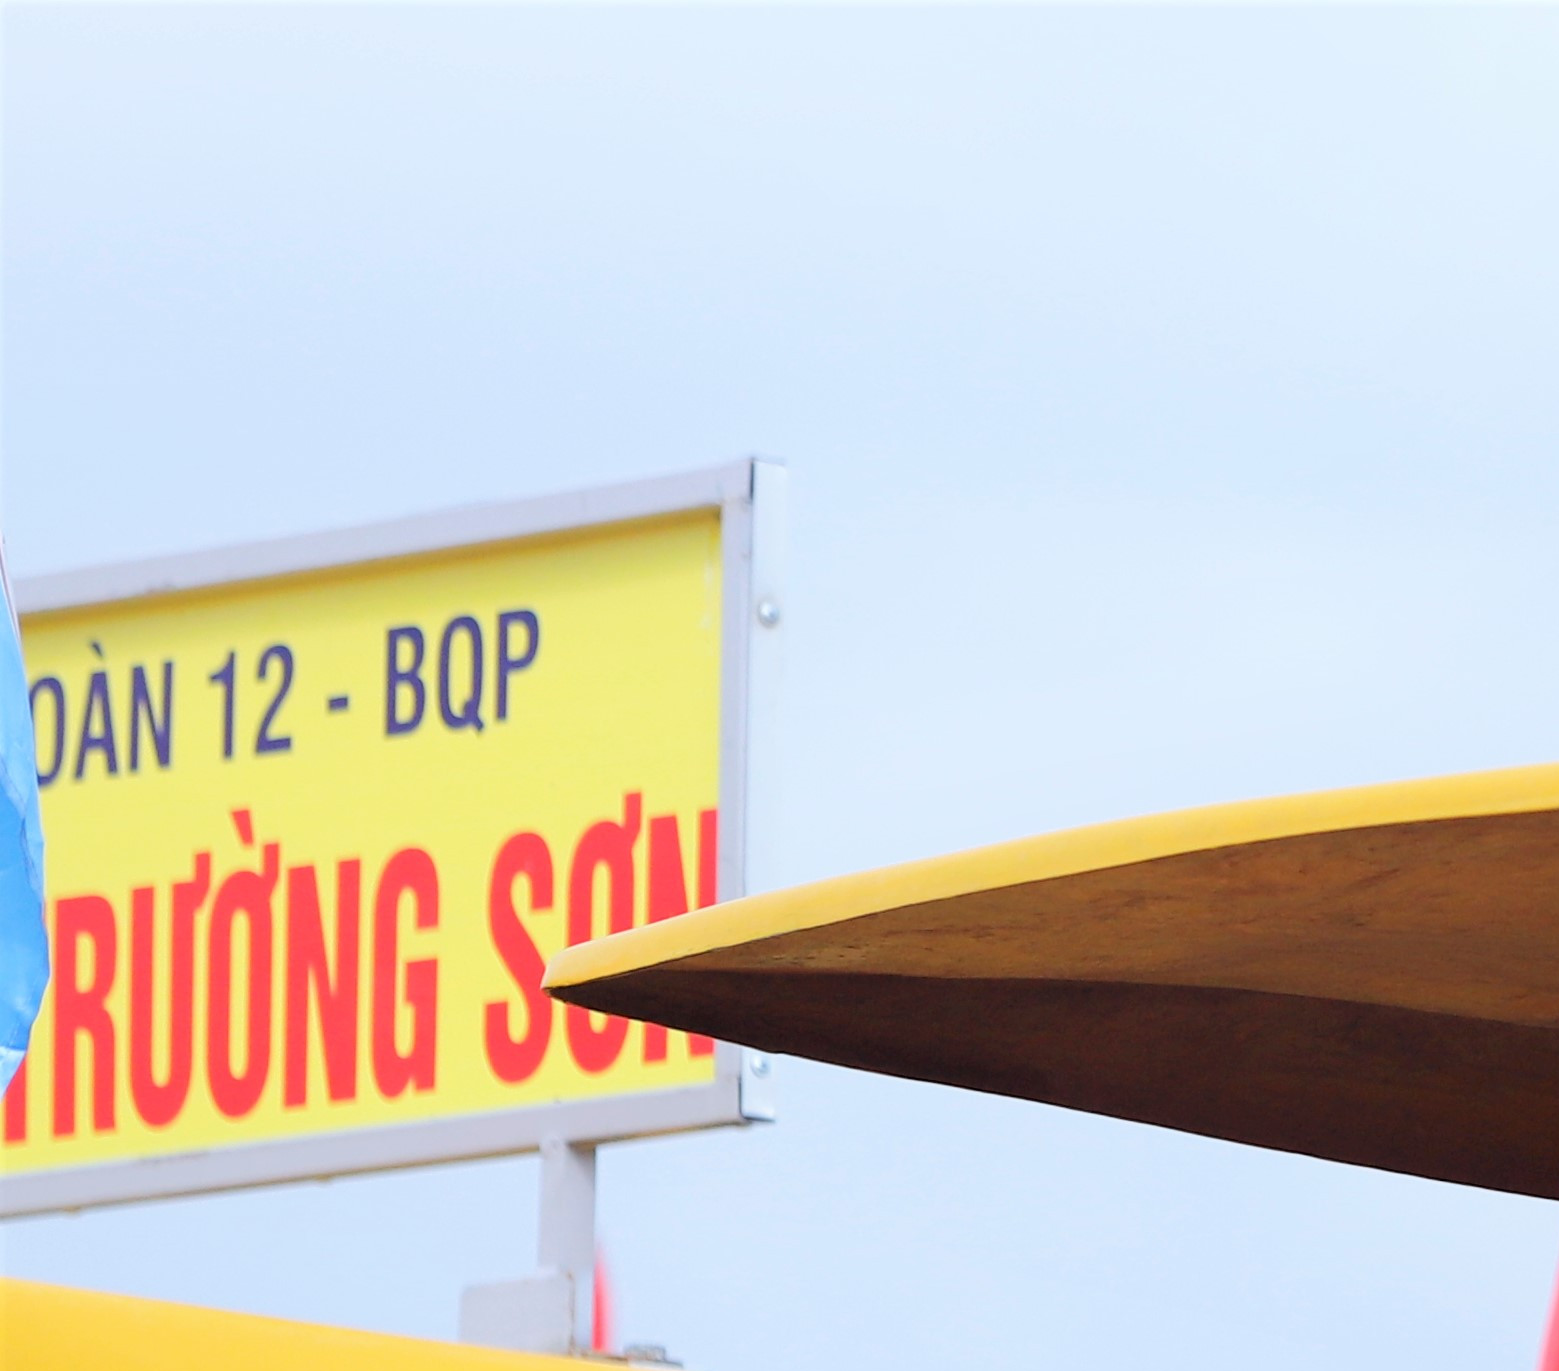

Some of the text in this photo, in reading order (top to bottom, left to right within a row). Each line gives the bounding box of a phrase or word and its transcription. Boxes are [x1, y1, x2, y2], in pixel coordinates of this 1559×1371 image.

[30, 640, 175, 790] OÀN
[208, 643, 295, 761] 12
[384, 608, 542, 737] BQP
